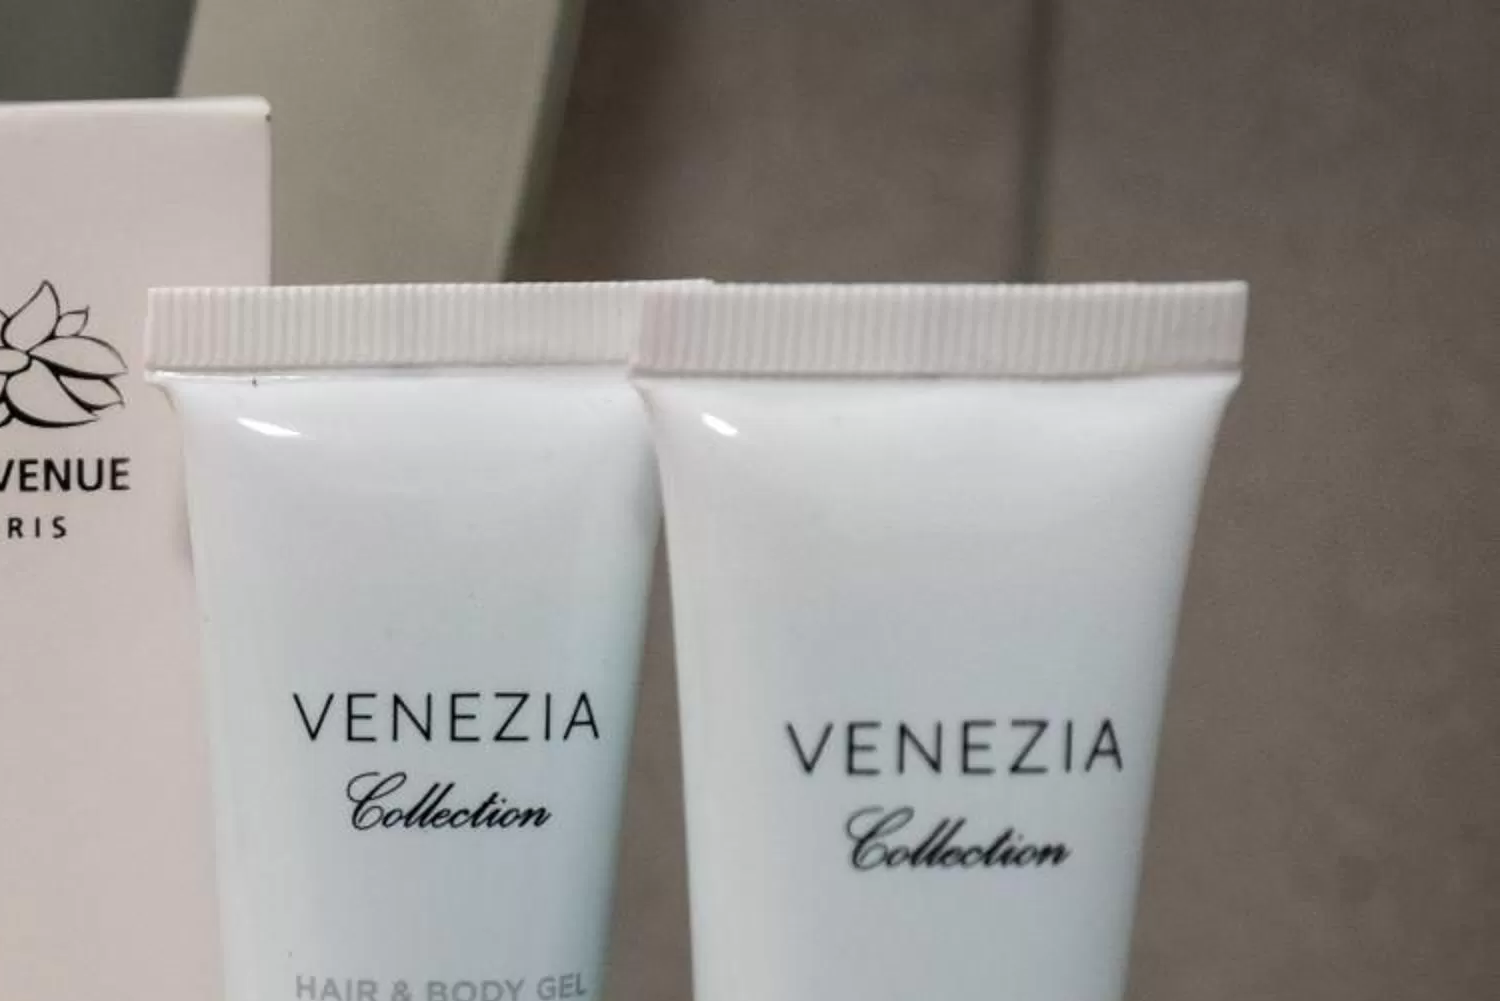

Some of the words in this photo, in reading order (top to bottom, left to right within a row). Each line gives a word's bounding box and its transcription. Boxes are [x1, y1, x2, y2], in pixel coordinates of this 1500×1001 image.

[293, 691, 600, 743] VENEZIA
[785, 718, 1124, 776] VENEZIA
[346, 771, 552, 831] Collection
[845, 805, 1073, 871] Collection
[536, 972, 588, 1001] GEL
